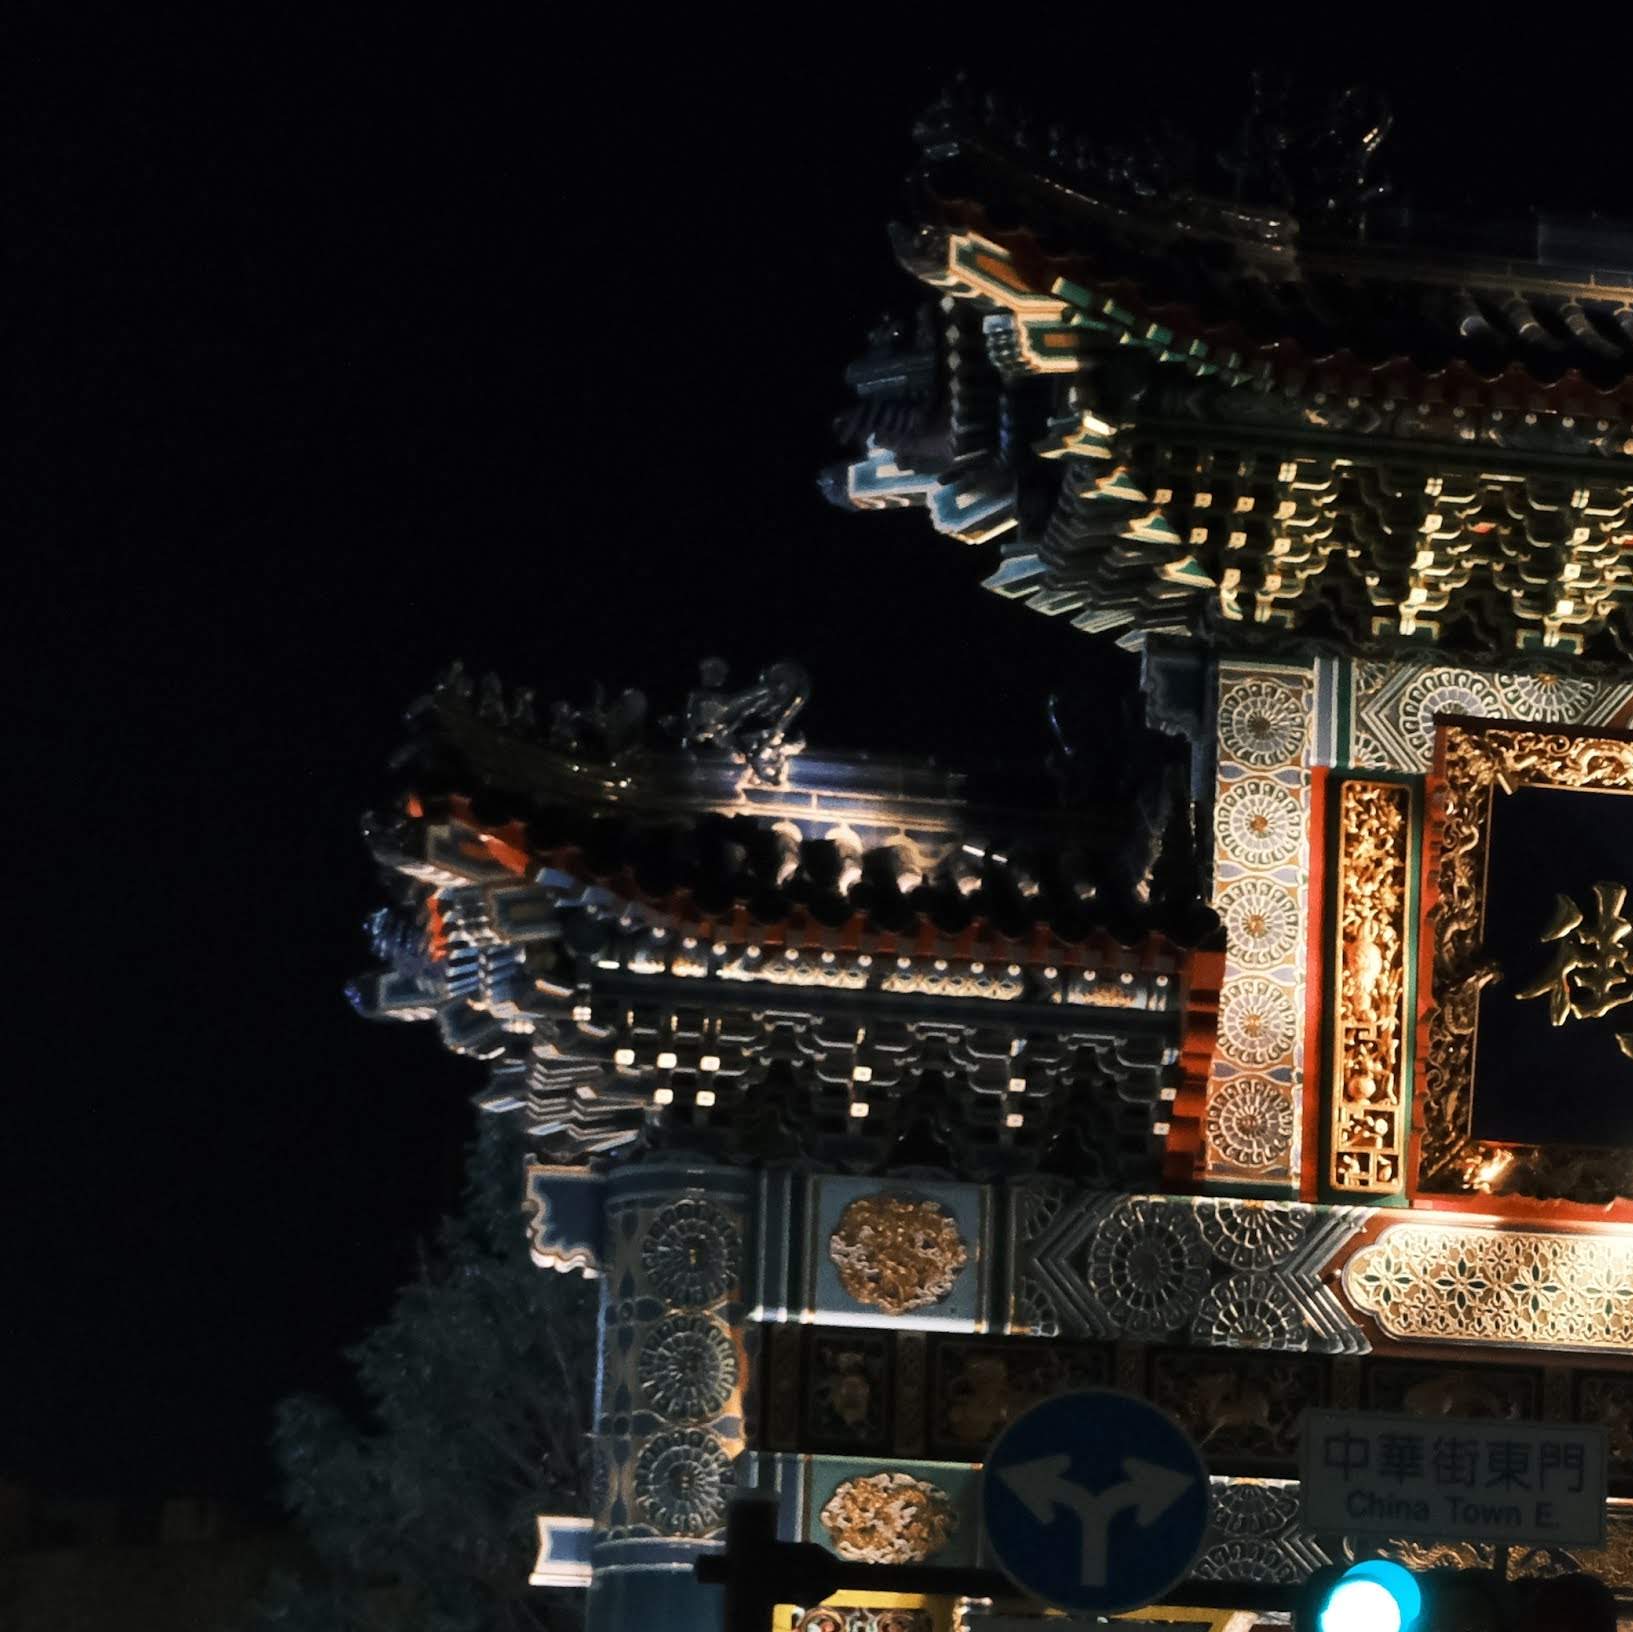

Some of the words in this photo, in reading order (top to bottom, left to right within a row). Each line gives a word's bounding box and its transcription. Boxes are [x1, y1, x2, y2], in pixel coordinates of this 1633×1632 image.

[1323, 1427, 1585, 1492] 中華街東門
[1346, 1489, 1430, 1521] China
[1443, 1496, 1521, 1527] Town
